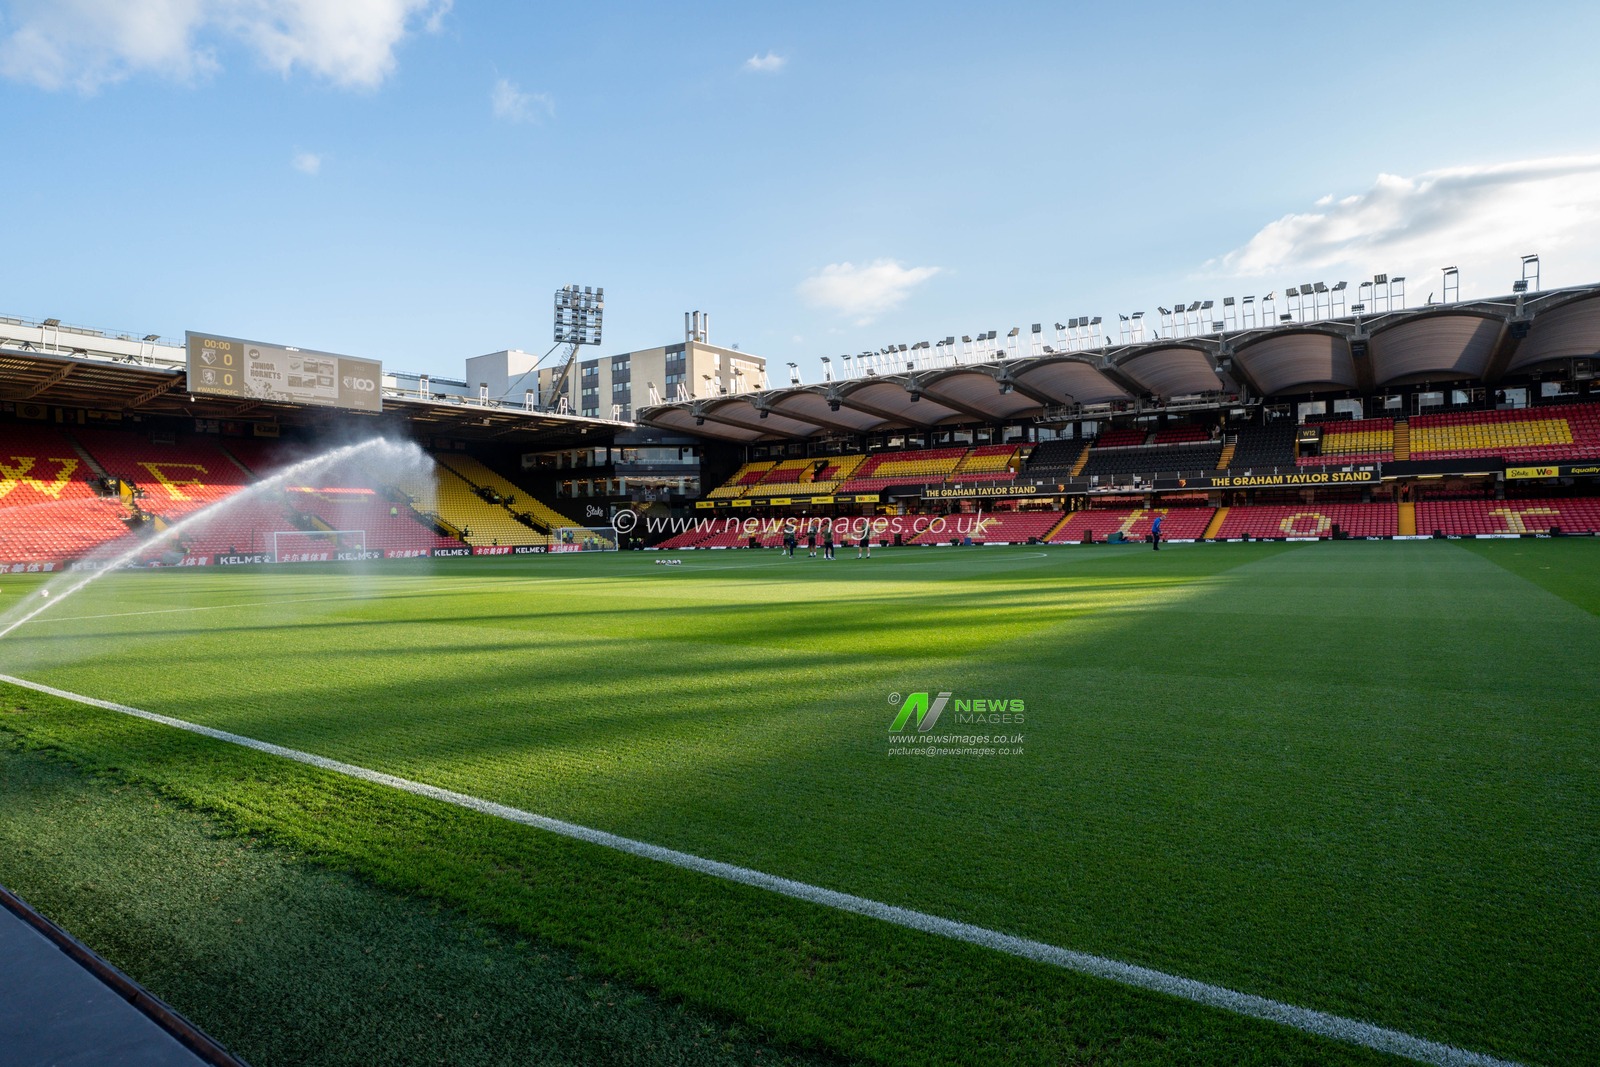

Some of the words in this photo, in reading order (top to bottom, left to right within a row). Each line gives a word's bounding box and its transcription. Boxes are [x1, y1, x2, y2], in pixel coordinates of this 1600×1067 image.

[204, 339, 230, 351] 00:00
[223, 353, 233, 366] 0
[251, 361, 276, 371] JUNIOR
[223, 373, 233, 386] 0
[250, 369, 282, 380] HORNETS
[1211, 477, 1230, 487] THE
[1232, 475, 1283, 486] GRAHAM
[1286, 473, 1329, 483] TAYLOR
[1332, 471, 1372, 482] STAND
[941, 488, 976, 497] GRAHAM
[978, 487, 1008, 495] TAYLOR
[1009, 486, 1037, 495] STAND
[434, 548, 464, 557] KELME
[515, 546, 540, 554] KELME
[220, 555, 262, 565] KELME
